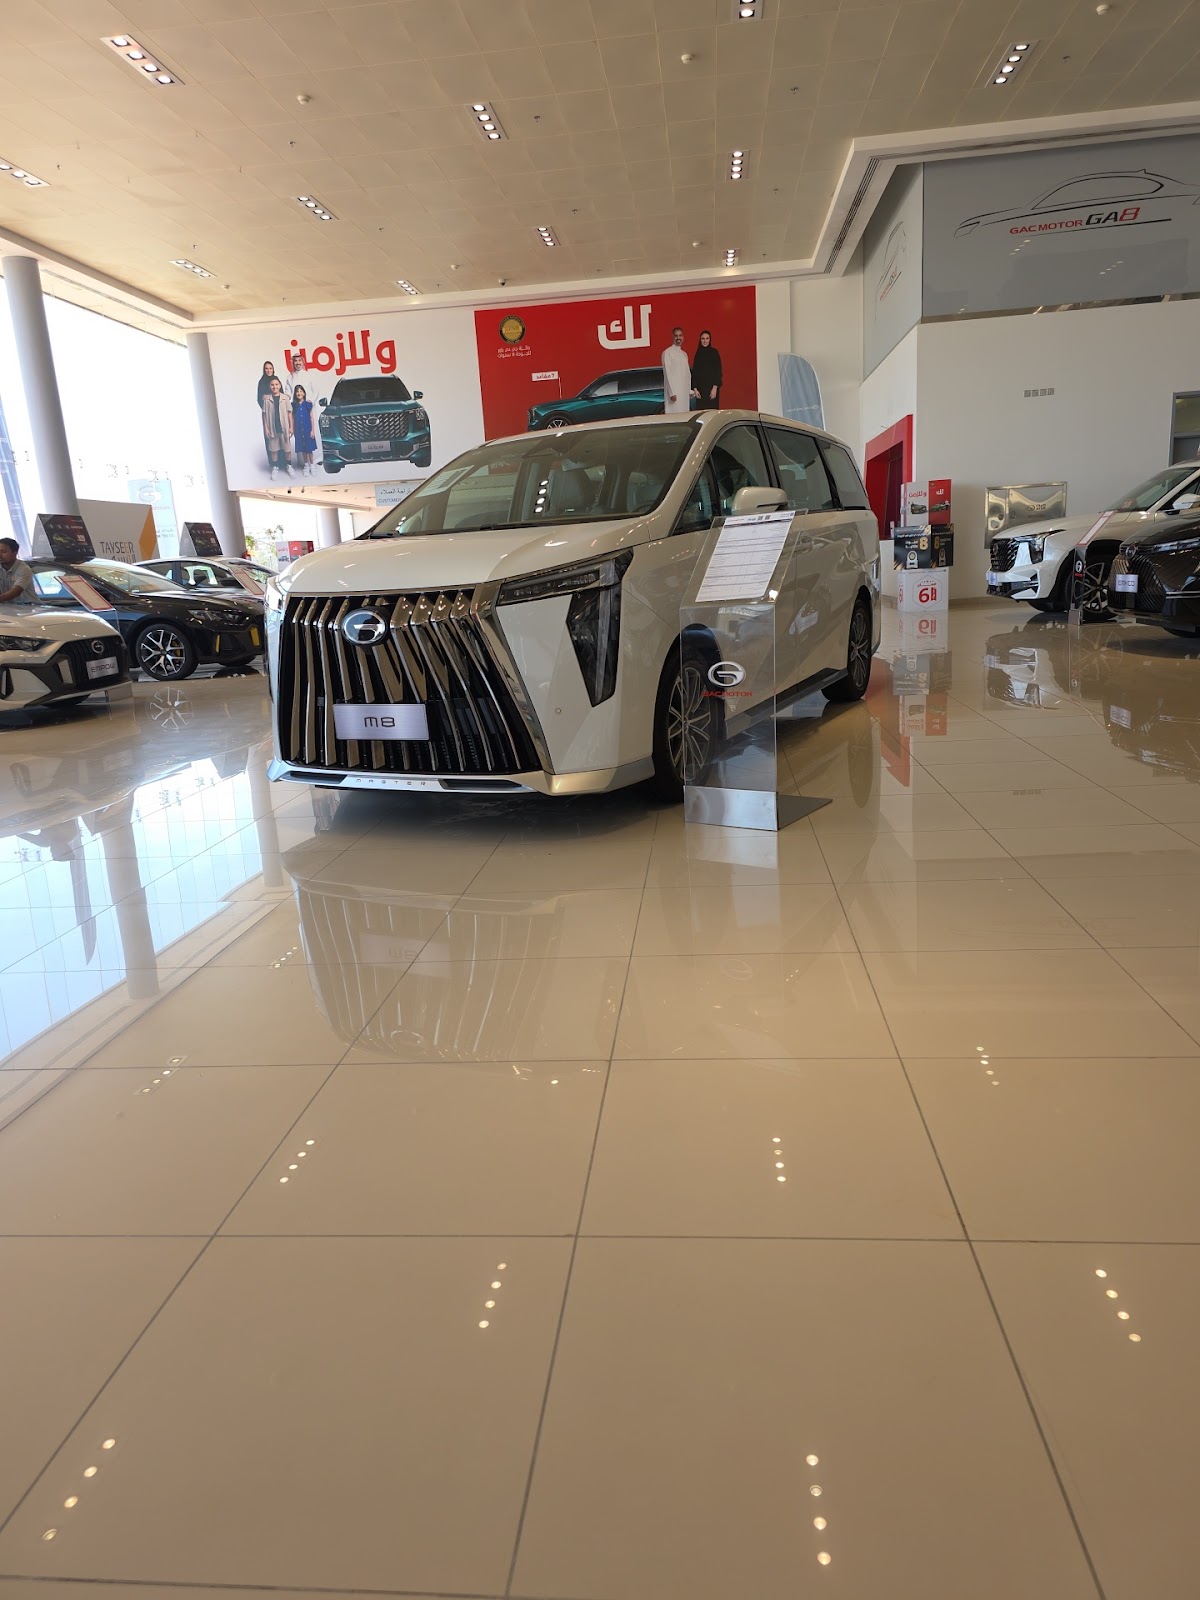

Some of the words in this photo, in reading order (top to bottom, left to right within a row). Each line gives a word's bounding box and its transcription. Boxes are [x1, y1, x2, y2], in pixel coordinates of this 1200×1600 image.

[1009, 225, 1037, 235] GAC
[1038, 219, 1083, 231] MOTOR
[1085, 207, 1141, 226] GA8
[597, 304, 652, 350] لك
[99, 541, 135, 554] TAYSEER
[919, 536, 929, 551] 8
[918, 587, 930, 604] 6
[363, 715, 396, 728] M8
